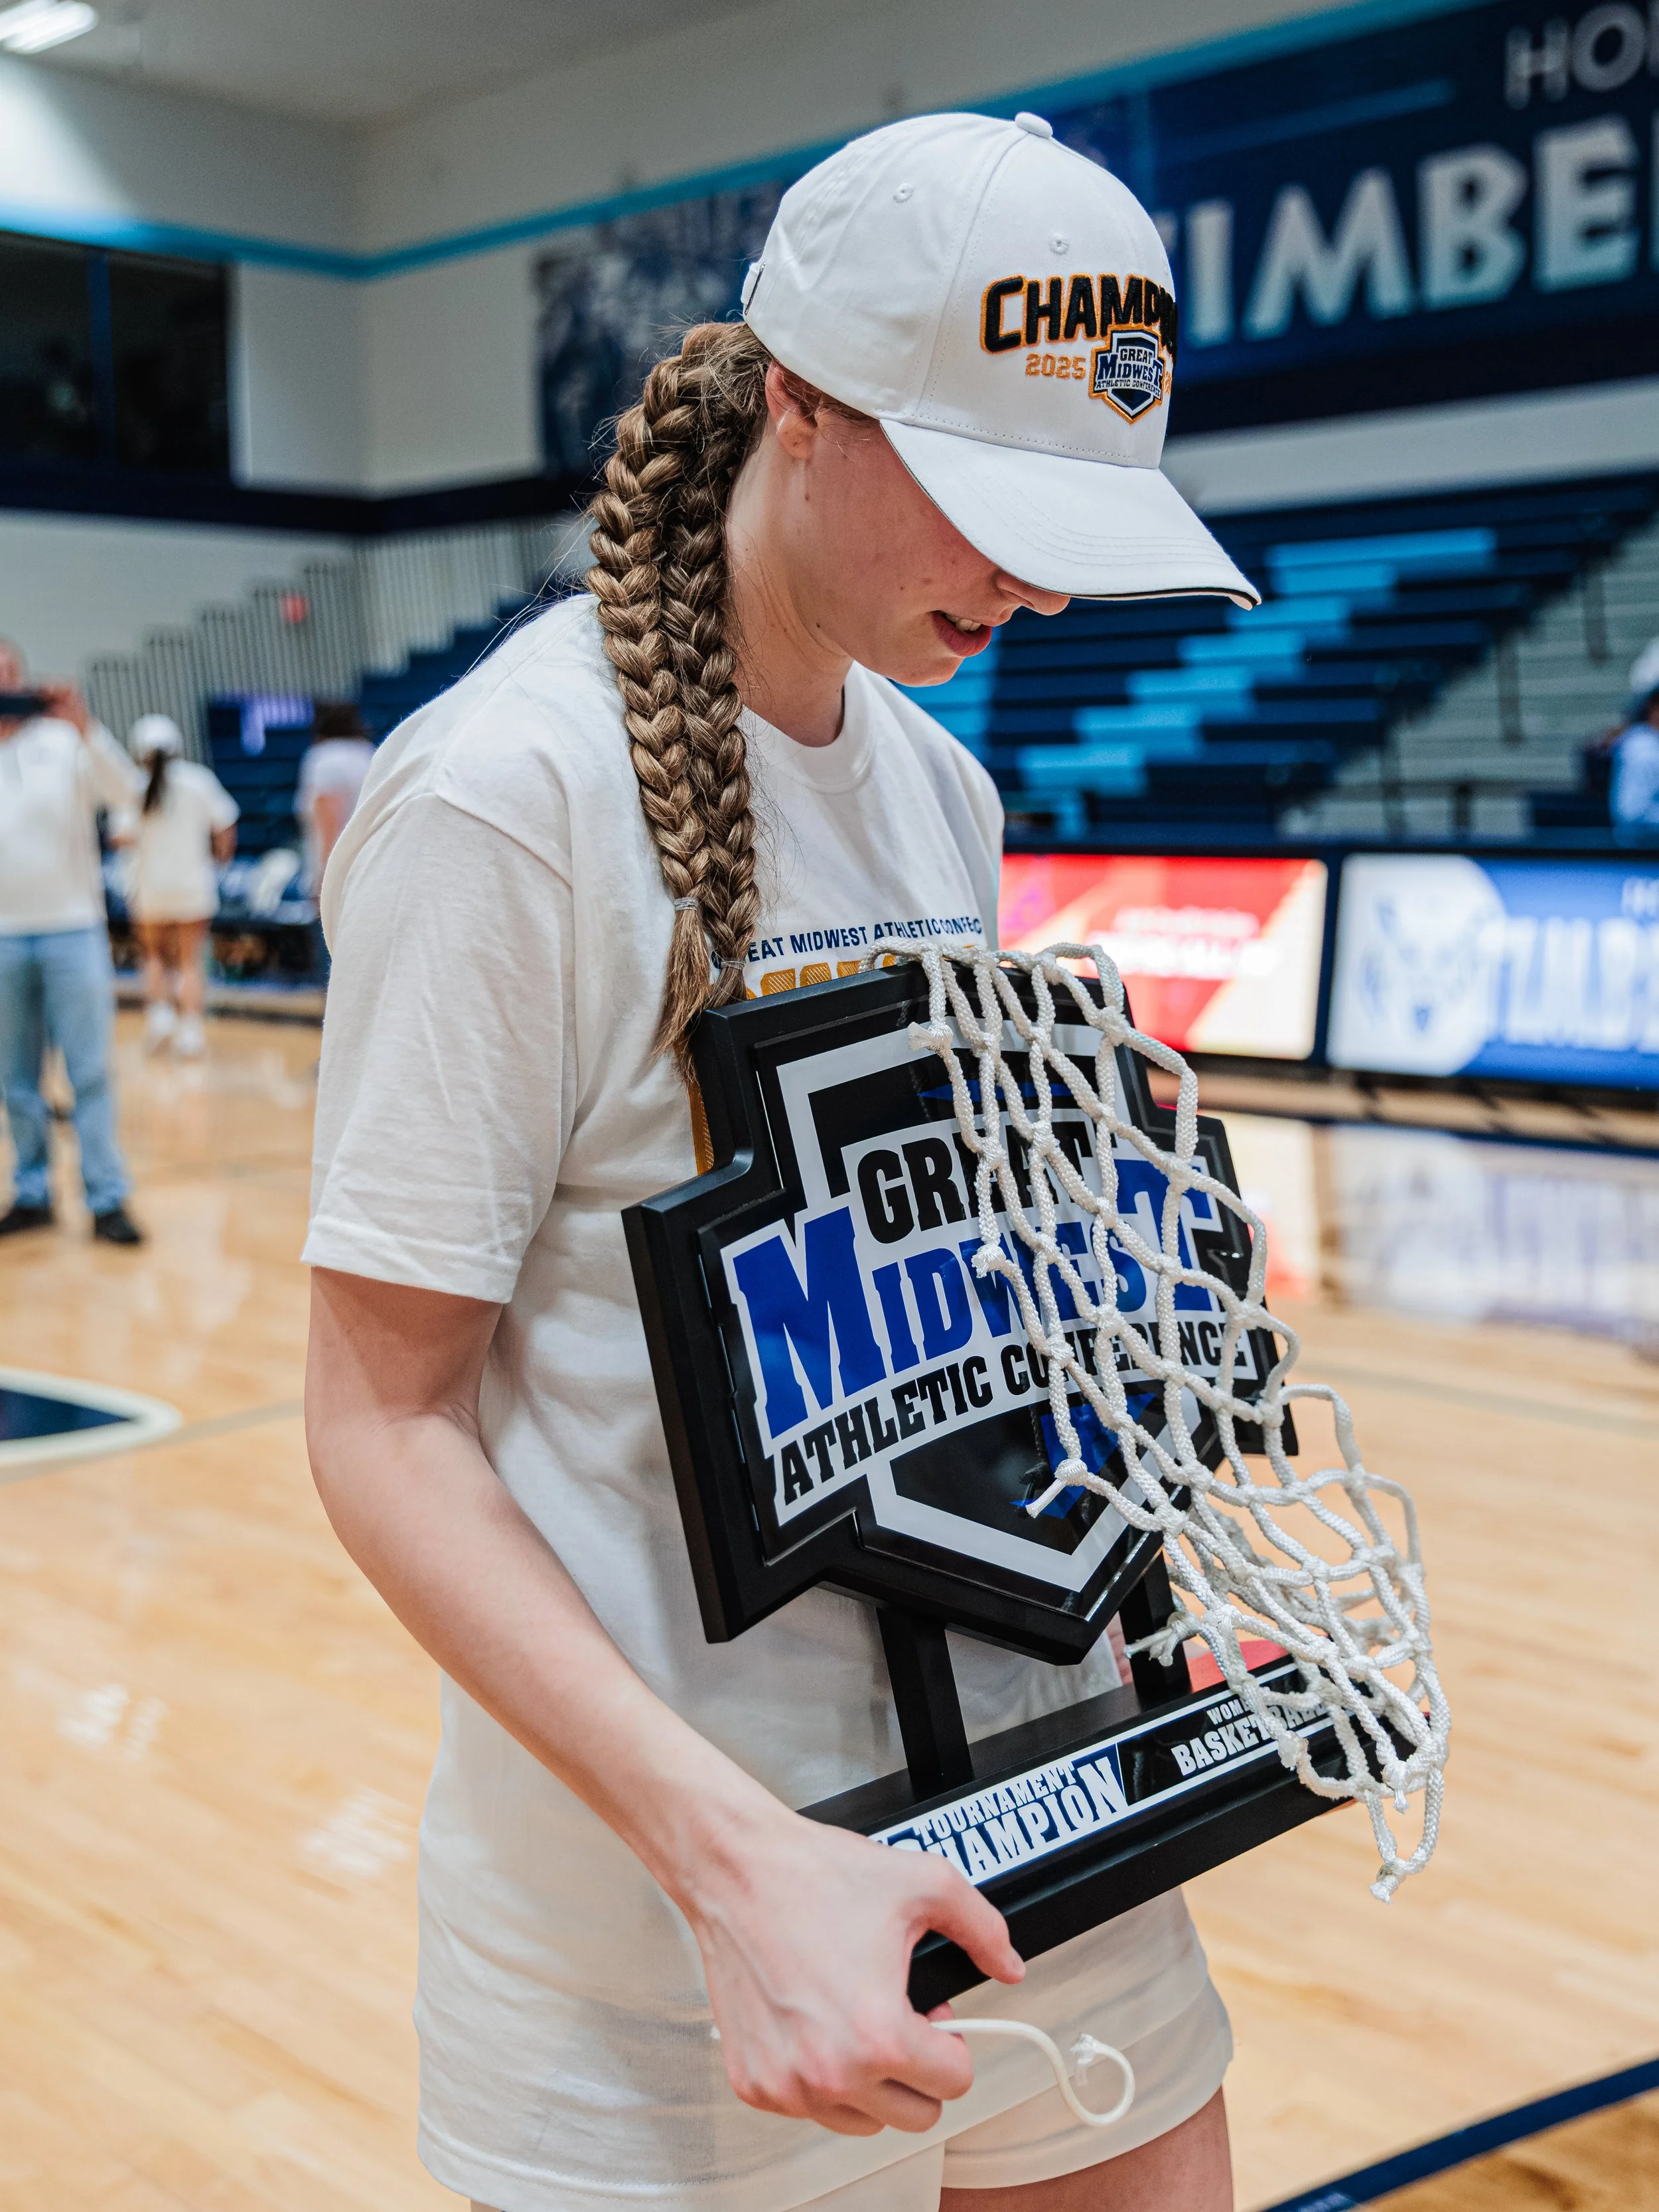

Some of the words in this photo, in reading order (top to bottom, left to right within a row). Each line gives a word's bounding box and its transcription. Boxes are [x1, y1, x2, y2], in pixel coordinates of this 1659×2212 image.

[1504, 3, 1659, 110] HO
[1151, 110, 1659, 348] IMBE
[1025, 353, 1086, 380] 2025
[1096, 379, 1131, 389] ATHLETIC
[1132, 380, 1161, 397] CONFERENCE
[1097, 354, 1163, 386] MIDWEST
[1119, 348, 1153, 364] GREAT
[790, 926, 868, 954] MIDWEST
[874, 918, 942, 941] ATHLETIC
[733, 1159, 1213, 1439] MIDWEST
[782, 1355, 993, 1505] ATHLETIC
[891, 1757, 1125, 1880] HAMPION
[915, 1766, 1076, 1844] TOURNAMENT
